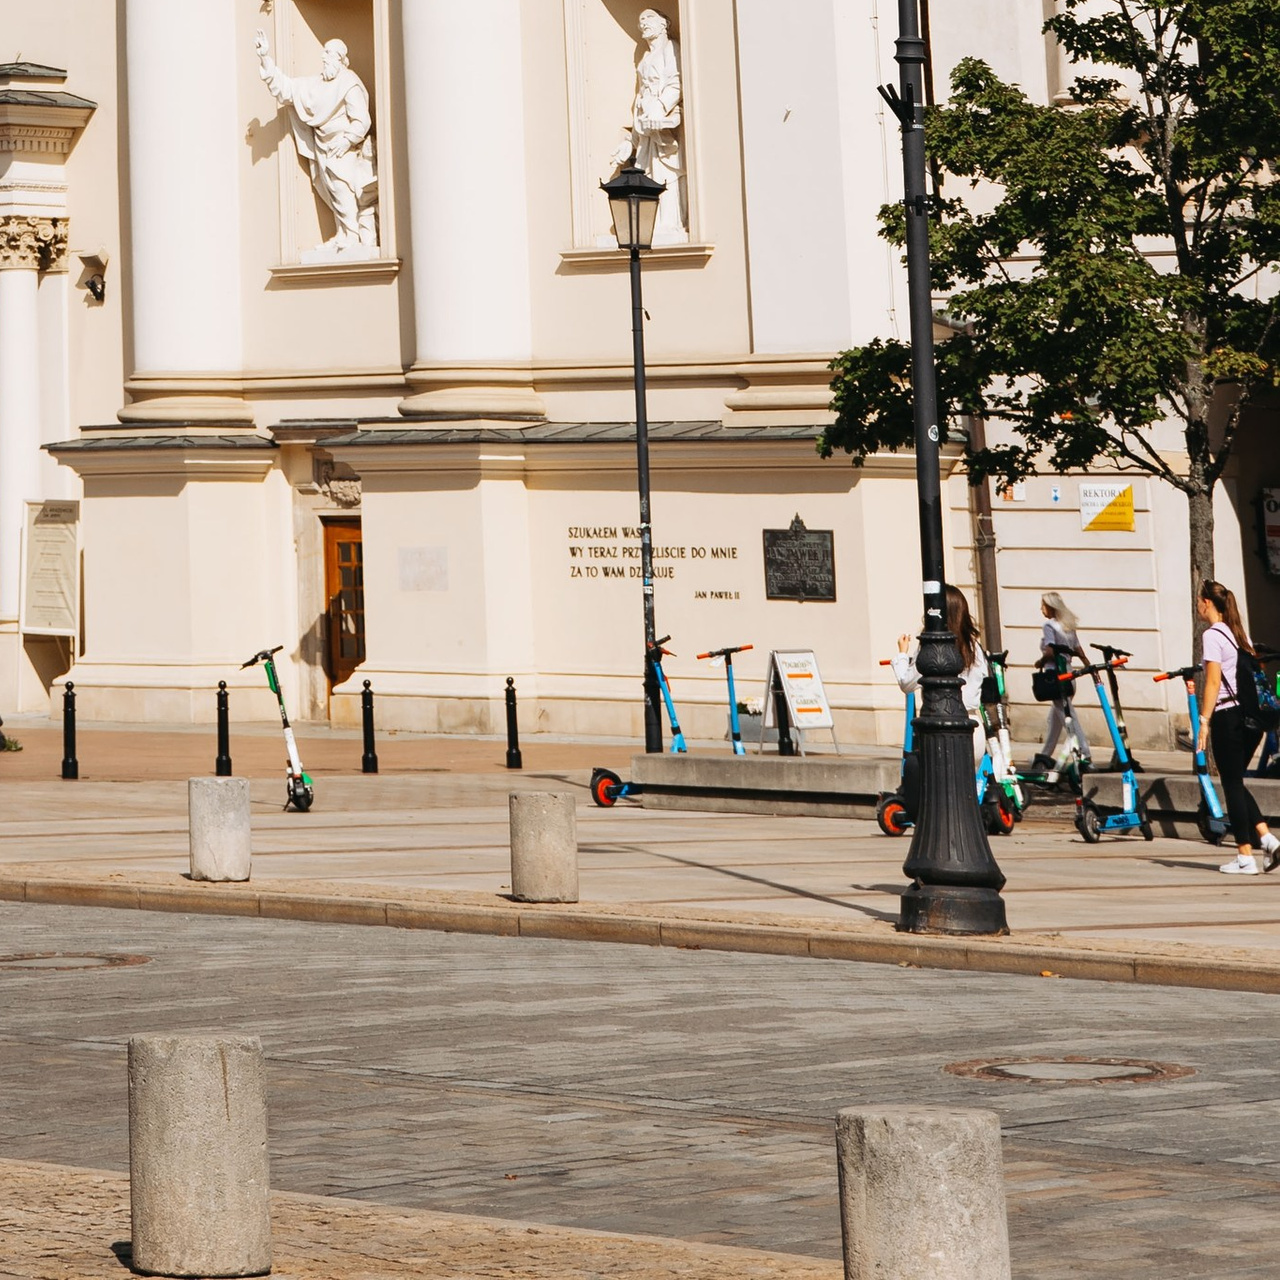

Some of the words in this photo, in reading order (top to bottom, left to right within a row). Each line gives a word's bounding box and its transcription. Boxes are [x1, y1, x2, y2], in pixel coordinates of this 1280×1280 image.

[568, 526, 618, 539] SZUKAŁEM
[569, 546, 584, 559] WY
[588, 546, 618, 559] TERAZ
[691, 546, 707, 559] DO
[710, 546, 738, 560] MNIE
[570, 566, 583, 578] ZA
[586, 566, 599, 578] TO
[602, 566, 626, 578] WAM
[694, 590, 707, 599] JAN
[710, 590, 733, 600] PAWEŁ
